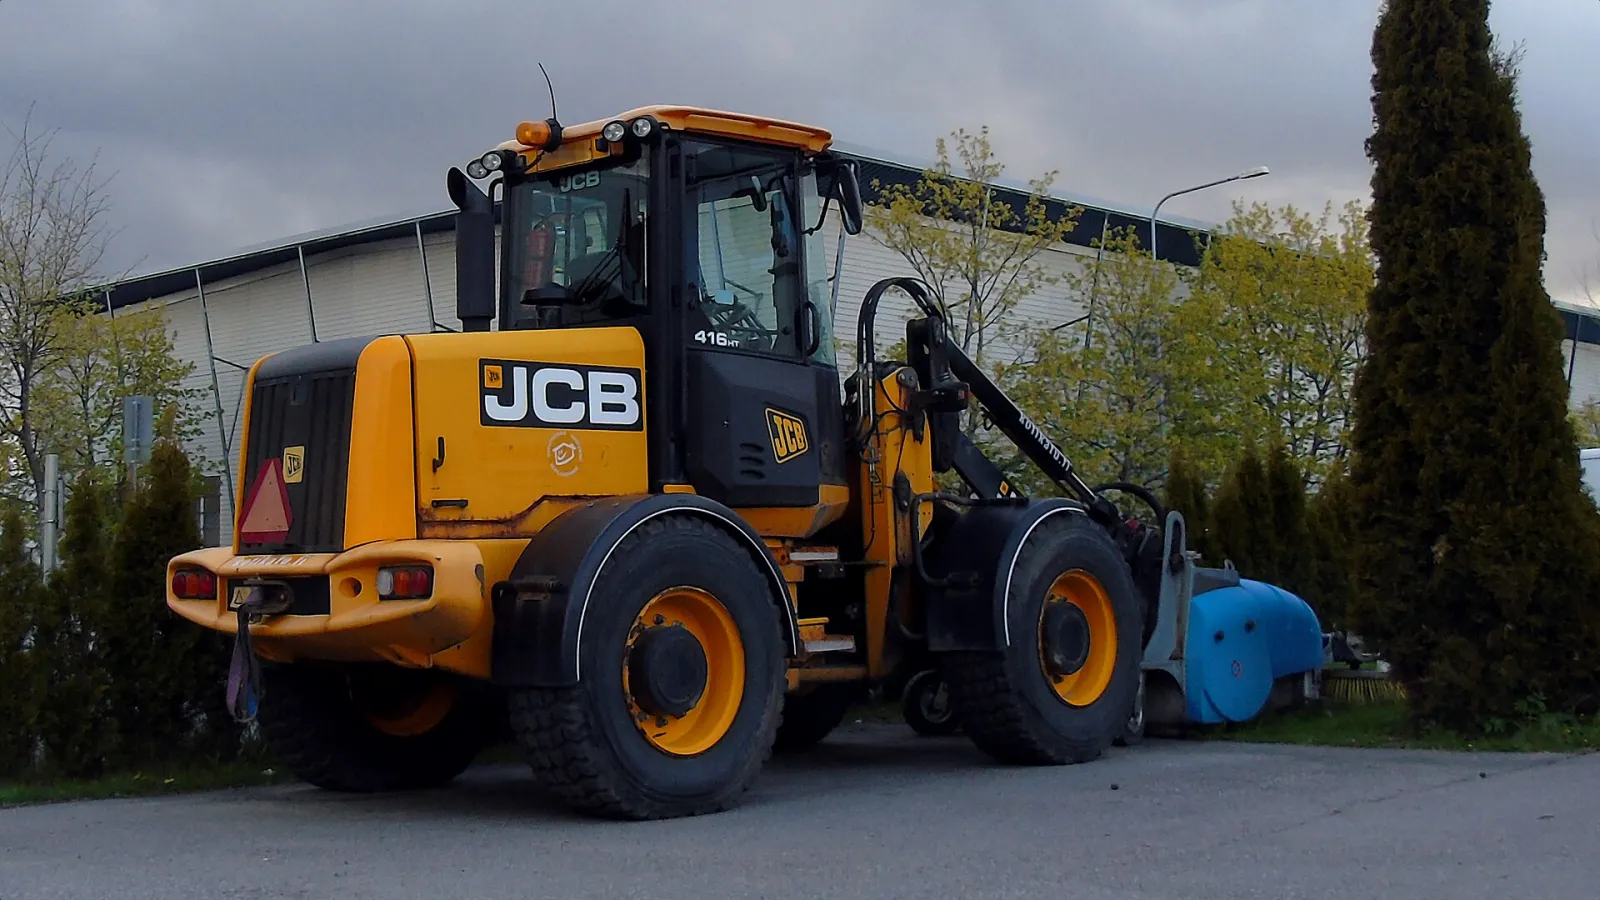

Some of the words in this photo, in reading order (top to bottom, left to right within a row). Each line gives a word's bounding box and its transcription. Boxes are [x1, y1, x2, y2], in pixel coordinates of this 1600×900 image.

[560, 170, 600, 193] JCB
[484, 366, 640, 425] JCB
[772, 414, 805, 457] JCB
[287, 455, 302, 475] JCB
